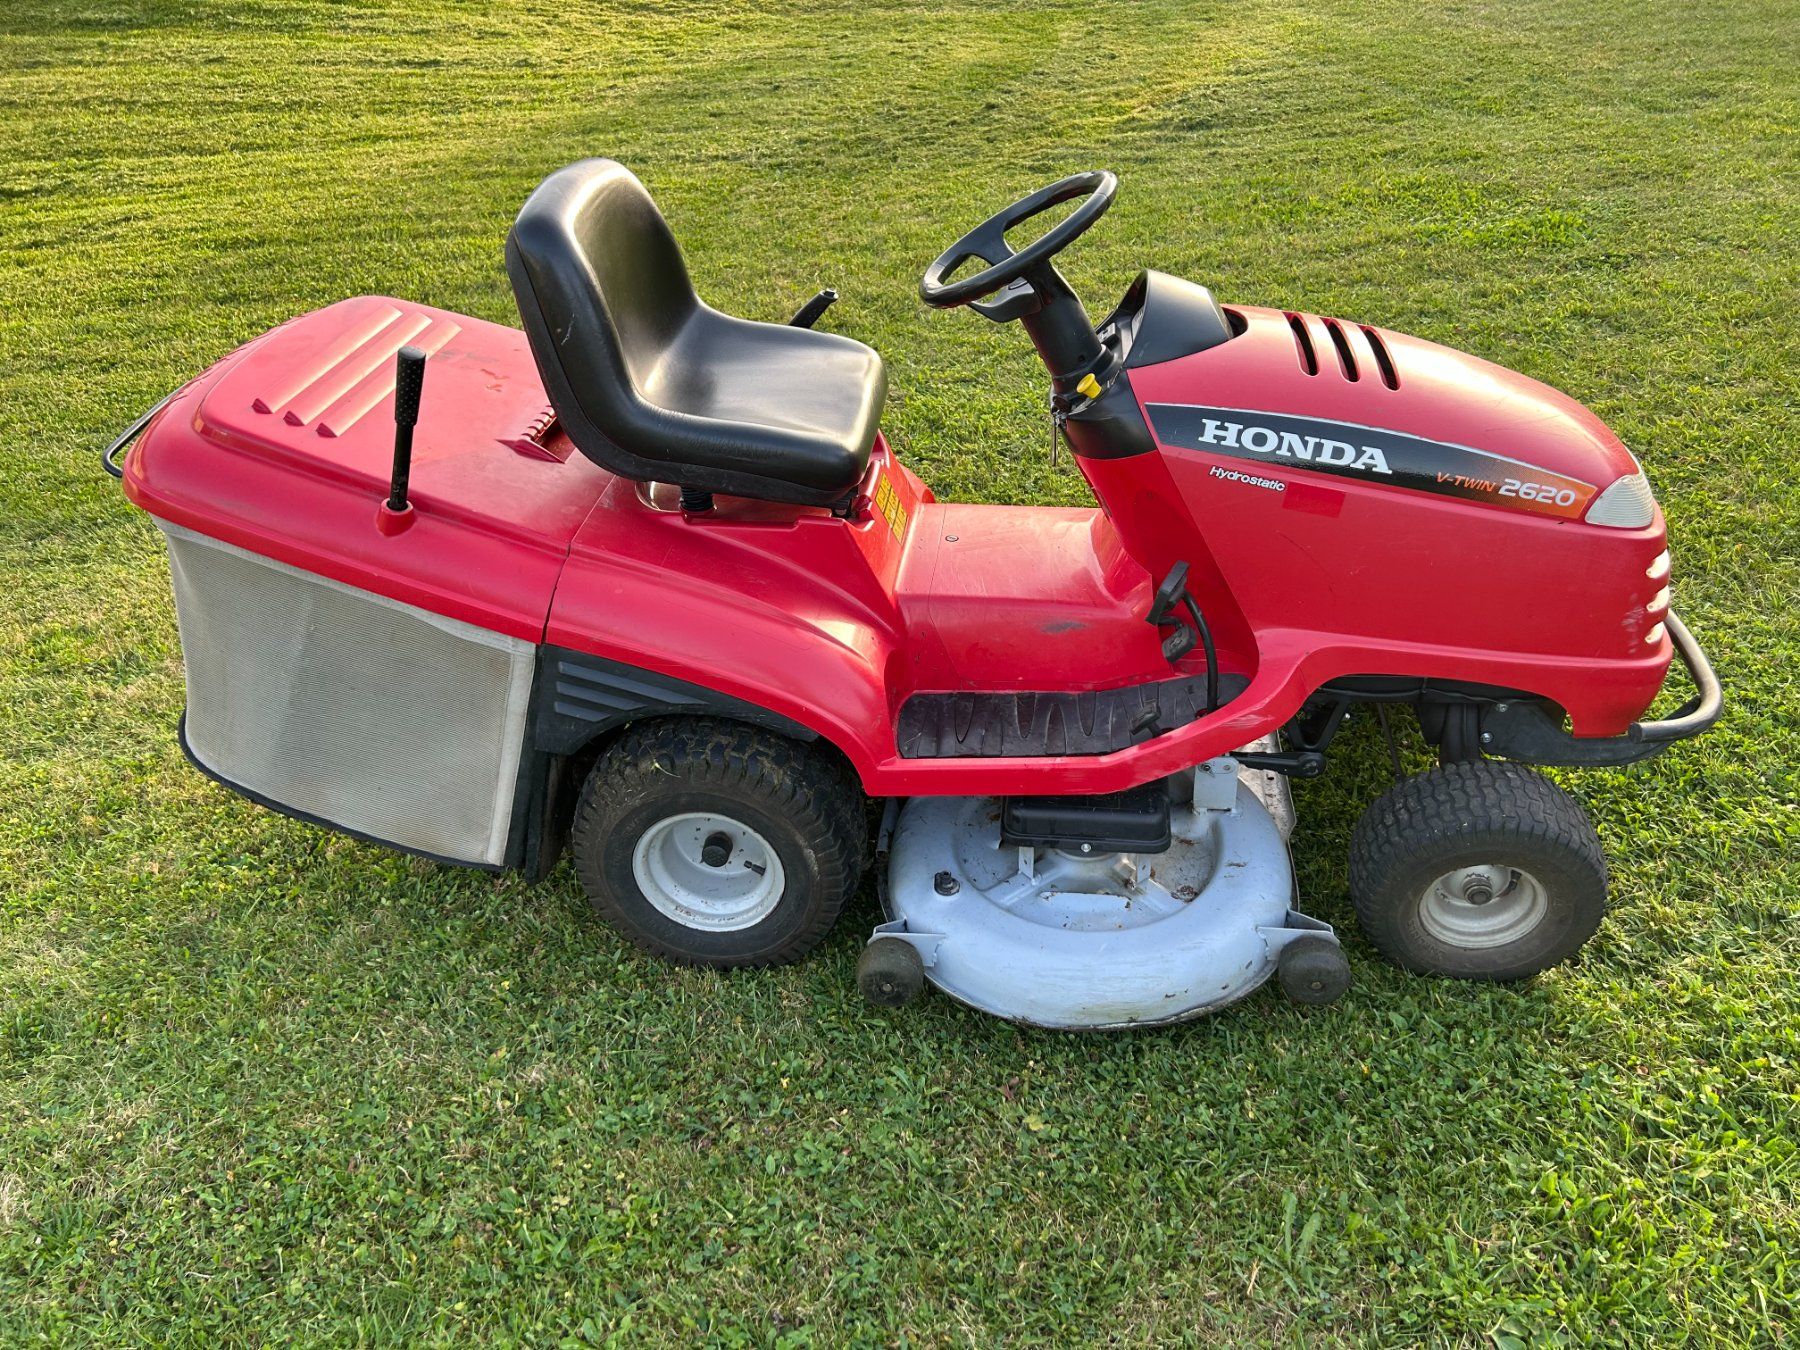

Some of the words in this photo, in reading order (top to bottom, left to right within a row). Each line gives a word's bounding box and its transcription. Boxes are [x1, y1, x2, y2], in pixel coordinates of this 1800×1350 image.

[1198, 418, 1392, 474] HONDA
[1209, 466, 1285, 492] Hydrostatic
[1436, 472, 1496, 492] V-TWIN
[1498, 478, 1576, 506] 2620
